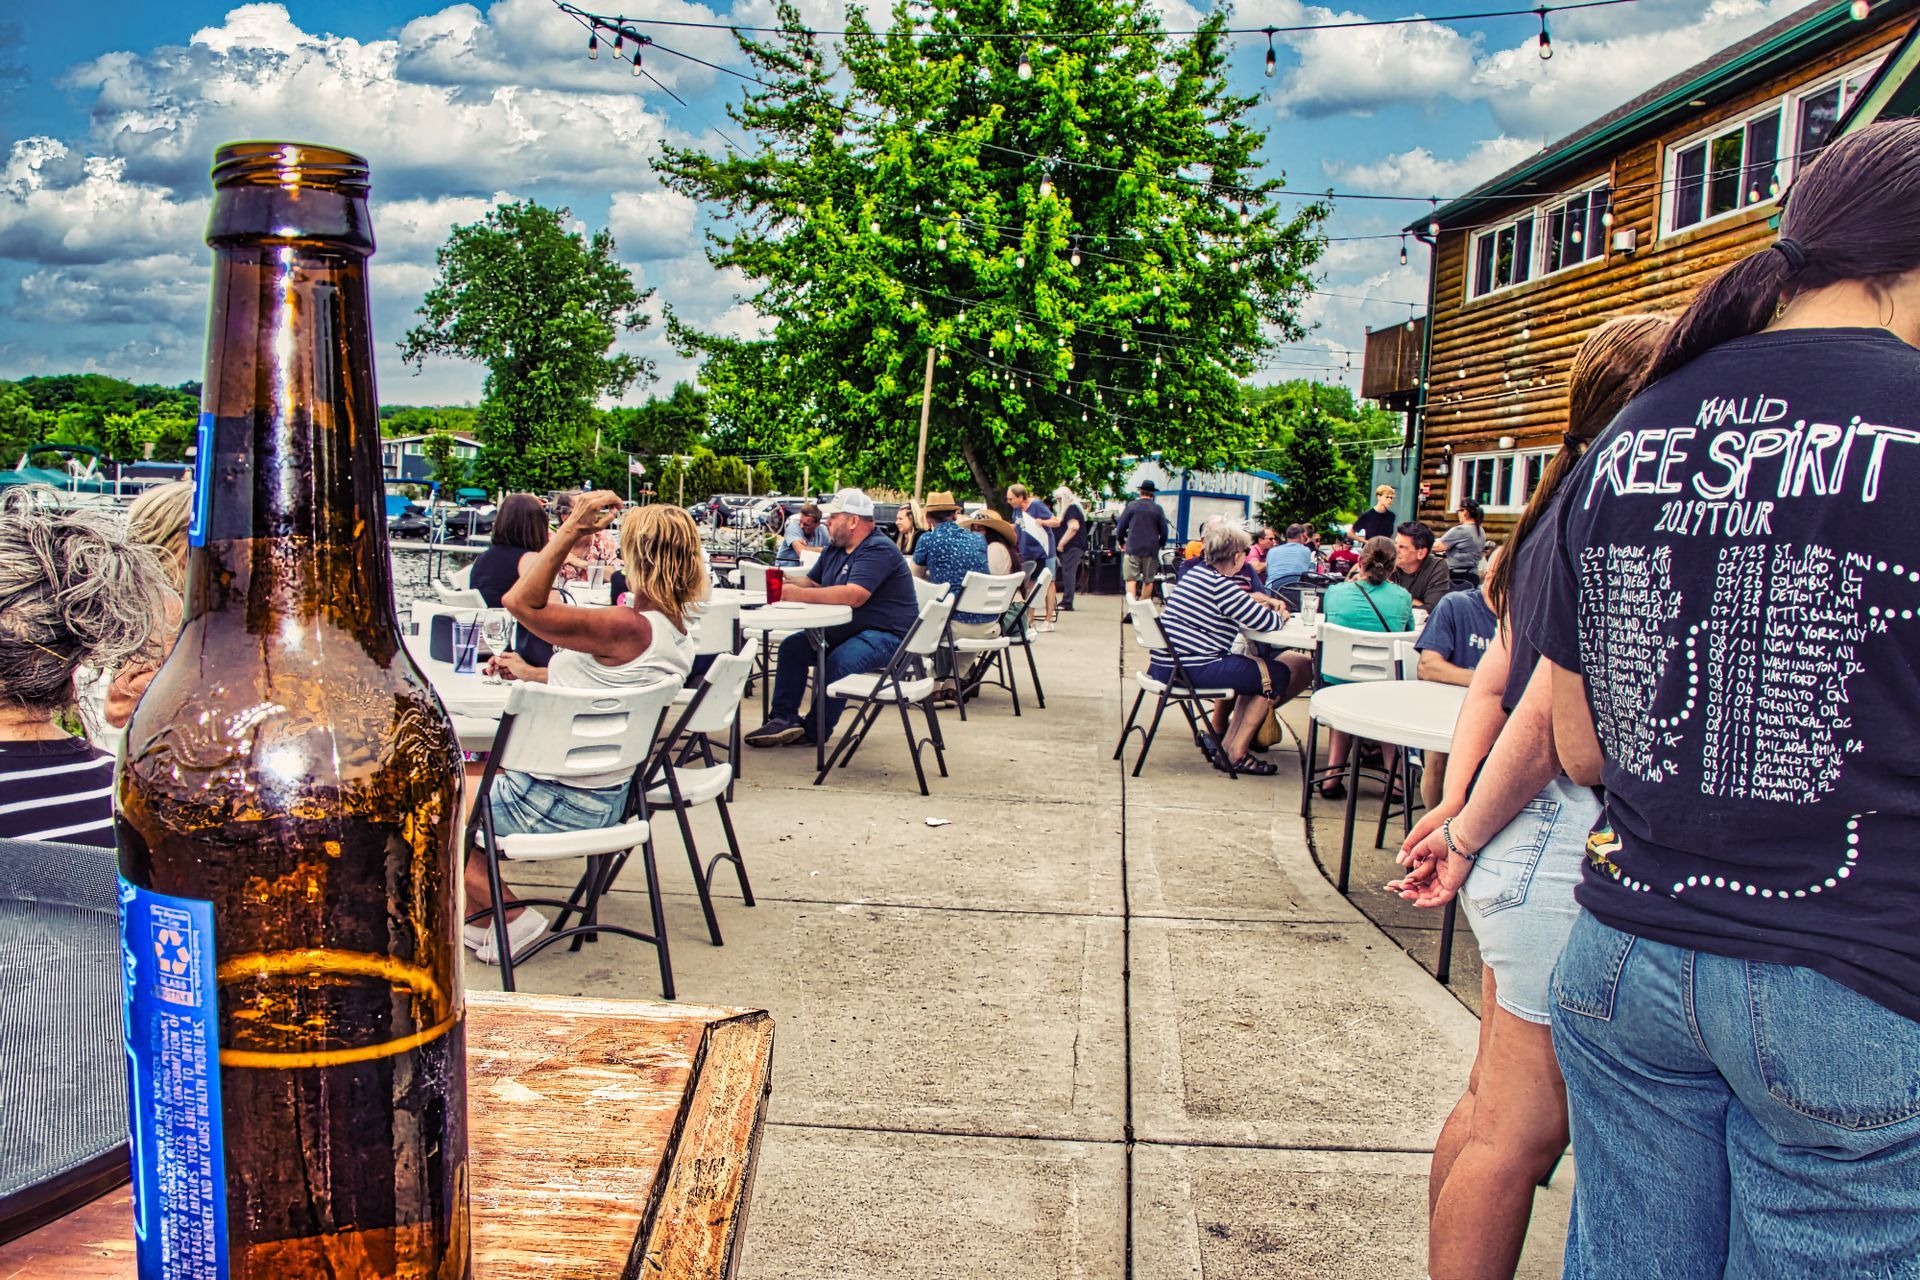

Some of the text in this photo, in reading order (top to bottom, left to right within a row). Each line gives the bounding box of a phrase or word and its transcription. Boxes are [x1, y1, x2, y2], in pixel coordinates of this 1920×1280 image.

[1775, 543, 1794, 559] ST.
[1845, 552, 1872, 571] MN
[1651, 558, 1671, 574] NV
[1843, 567, 1863, 582] IL
[1841, 581, 1862, 600] OH
[1668, 591, 1682, 606] CA
[1835, 596, 1854, 609] MI
[1667, 606, 1681, 618] CA
[1645, 619, 1659, 632] CA
[1765, 622, 1798, 637] NEW
[1846, 627, 1867, 642] NY
[1870, 618, 1888, 634] PA
[1763, 638, 1794, 653] NEW
[1836, 646, 1854, 660] NY
[1845, 662, 1865, 675] DC
[1826, 675, 1848, 690] CT
[1826, 689, 1849, 703] ON
[1820, 704, 1839, 717] ON
[1832, 717, 1852, 728] QC
[1812, 730, 1832, 742] MA
[1845, 740, 1864, 752] PA
[1830, 754, 1843, 766] NC
[1819, 768, 1840, 780] GA
[1818, 781, 1835, 792] FL
[1803, 792, 1820, 803] FL
[181, 1029, 193, 1061] DRIVE
[196, 1079, 208, 1117] HEALTH
